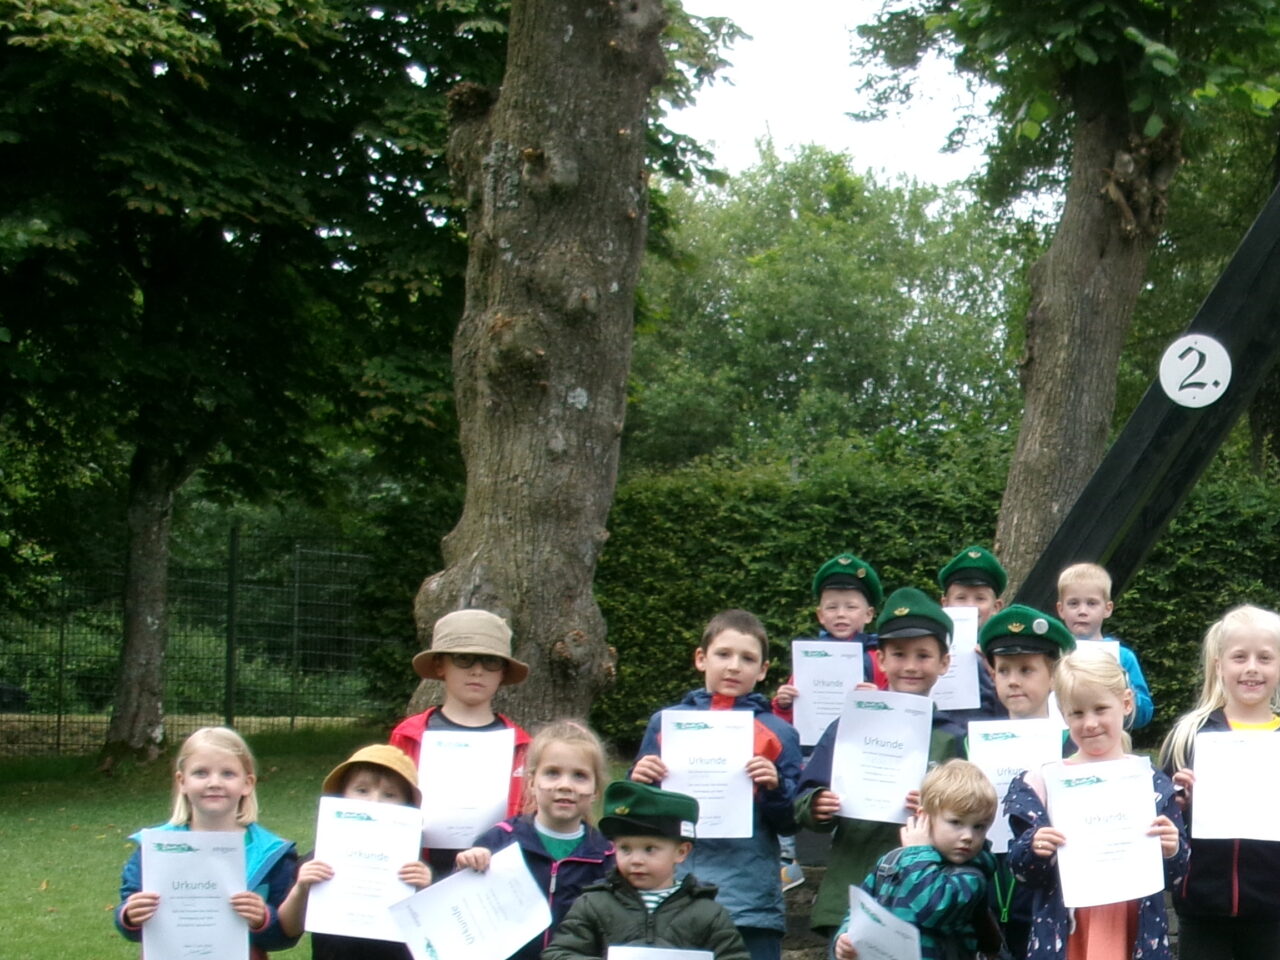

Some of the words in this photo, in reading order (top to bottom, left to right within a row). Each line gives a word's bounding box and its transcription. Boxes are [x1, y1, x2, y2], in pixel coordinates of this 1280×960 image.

[1178, 346, 1221, 392] 2.
[864, 736, 904, 750] Urkunde
[688, 756, 727, 766] Urkunde
[172, 880, 217, 890] Urkunde
